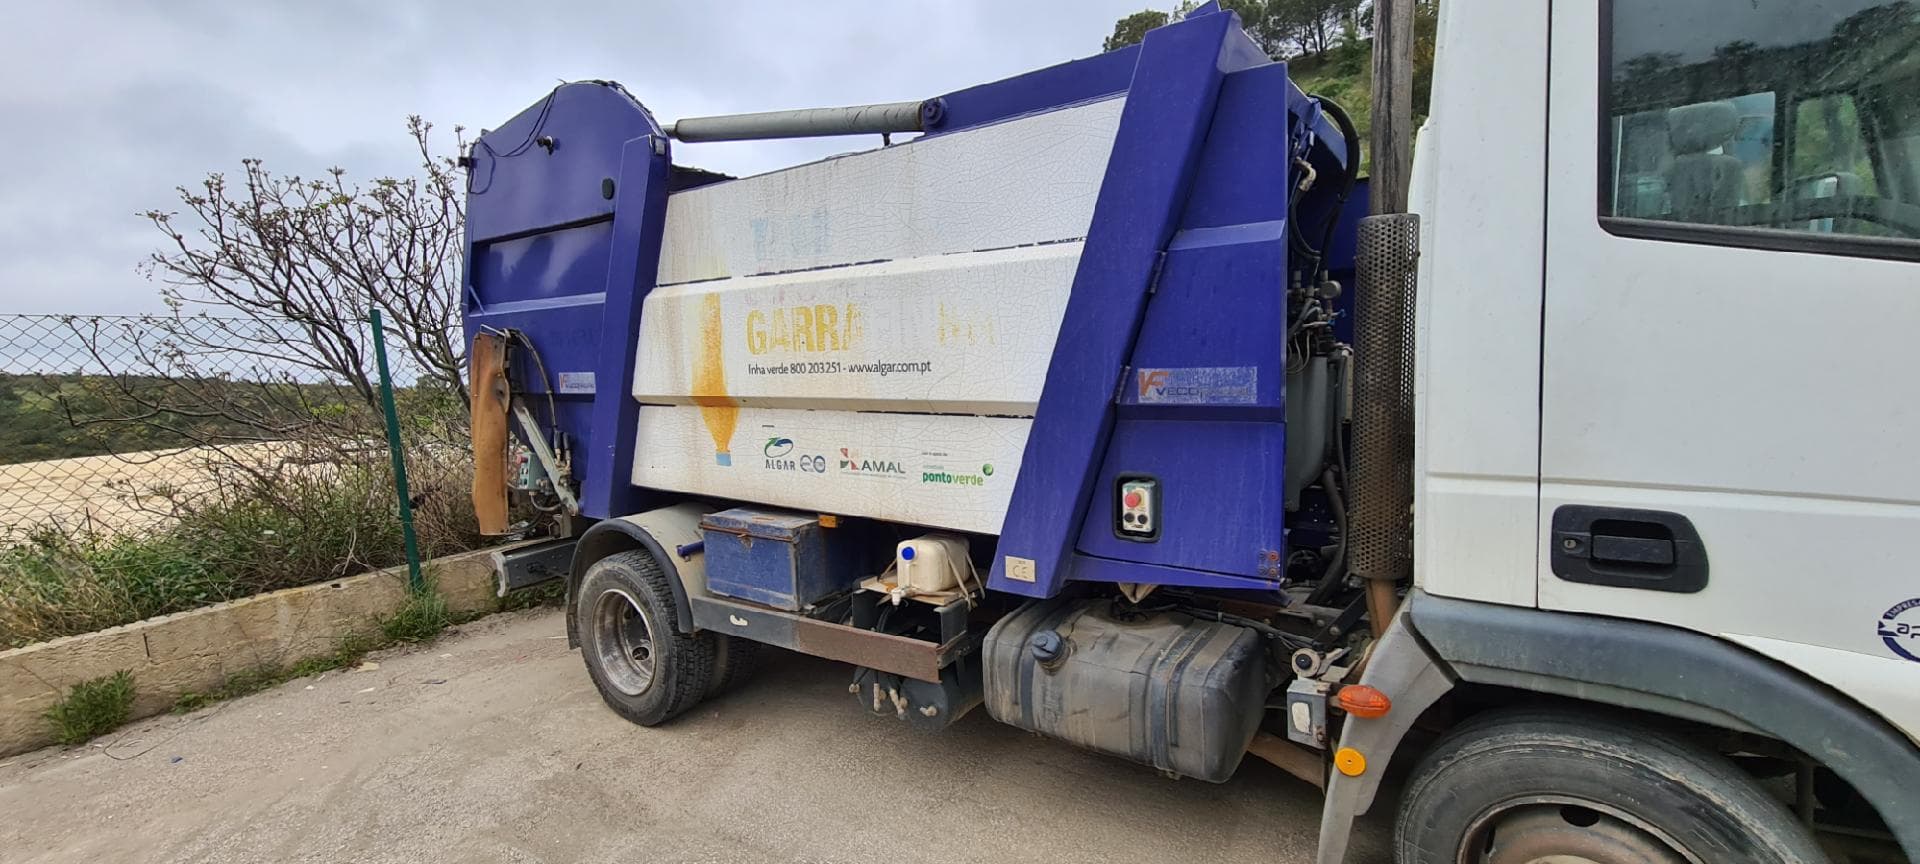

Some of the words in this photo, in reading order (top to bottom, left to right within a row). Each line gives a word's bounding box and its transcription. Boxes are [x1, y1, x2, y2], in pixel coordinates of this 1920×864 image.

[767, 362, 788, 375] verde
[790, 362, 806, 374] 800
[766, 459, 796, 471] ALGAR
[861, 460, 906, 474] AMAL
[922, 472, 984, 486] pontoverde
